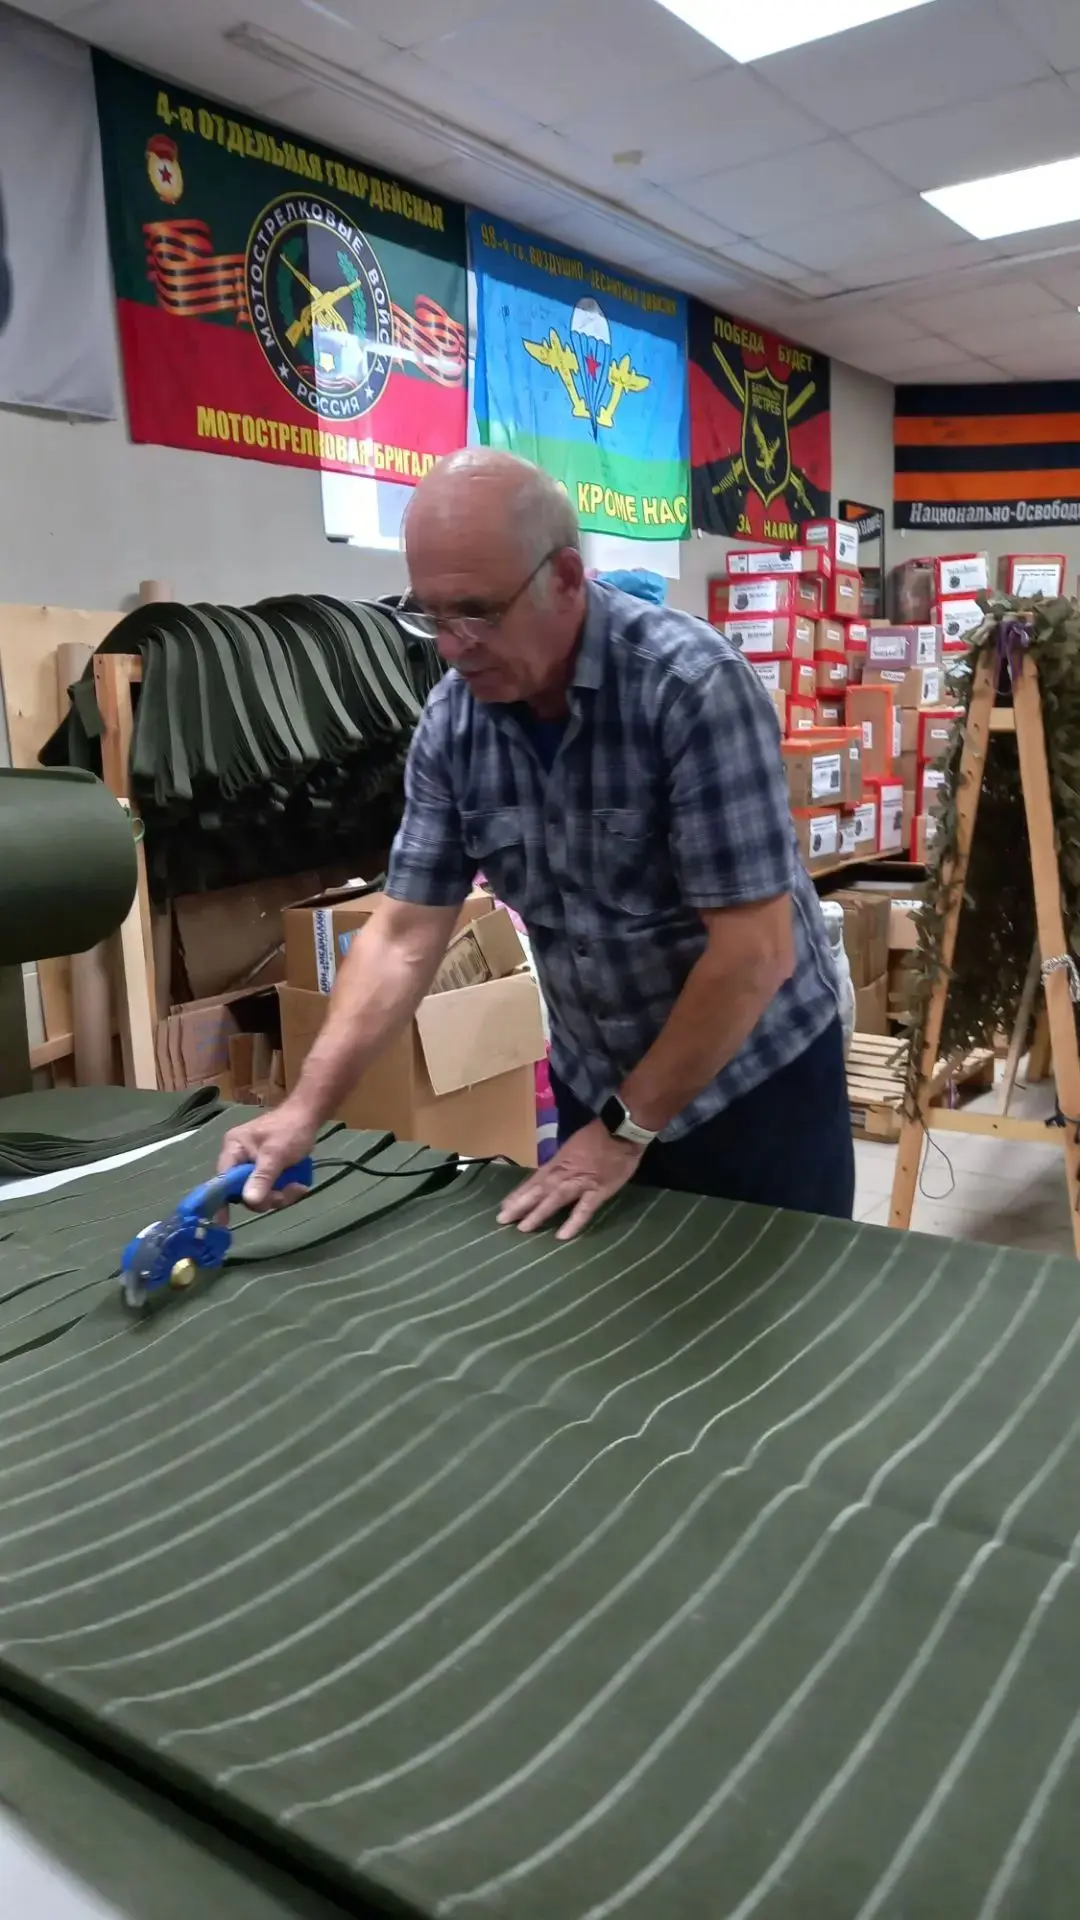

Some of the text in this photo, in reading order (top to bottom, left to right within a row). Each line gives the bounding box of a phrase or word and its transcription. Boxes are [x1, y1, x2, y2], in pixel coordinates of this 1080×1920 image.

[156, 90, 444, 233] 4-я ОТДЕЛЬНАЯ ГВАРДЕЙСКАЯ
[250, 201, 391, 376] МОТОСТРЕЛКОВЫЕ ВОЙСА
[713, 315, 813, 373] ПОБЕДА БУДЕТ
[297, 383, 360, 415] РОССИЯ
[196, 406, 443, 478] МОТОСТРЕЛКОВАЯ БРИГАД
[577, 481, 638, 524] КРОМЕ
[642, 496, 688, 525] НАС
[736, 514, 798, 540] ЗА НАМИ
